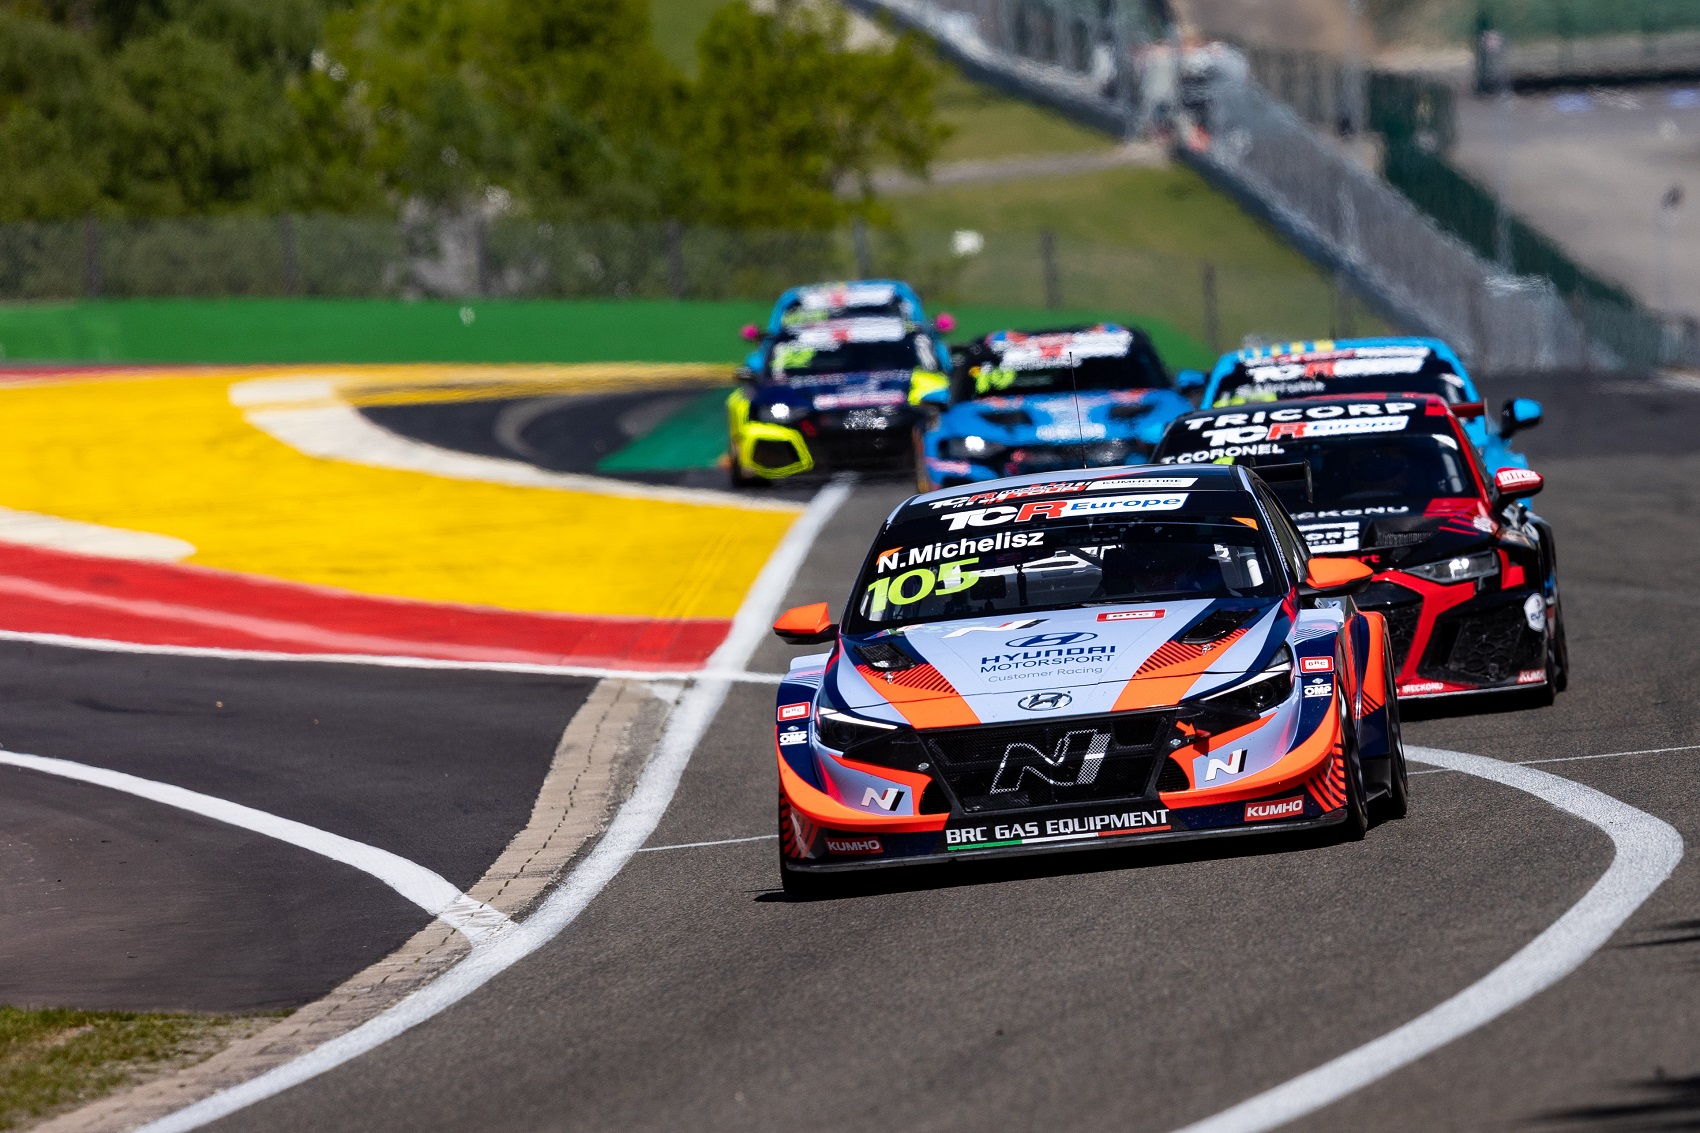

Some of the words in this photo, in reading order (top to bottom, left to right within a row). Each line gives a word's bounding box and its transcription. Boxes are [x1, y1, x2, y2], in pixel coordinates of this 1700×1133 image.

[1185, 402, 1416, 430] TRICORP
[1201, 421, 1307, 447] TCR
[940, 500, 1068, 531] TCR
[1070, 497, 1181, 511] Europe
[877, 532, 1044, 573] N.Michelisz
[867, 557, 980, 613] 105
[980, 655, 1116, 673] MOTORSPORT
[981, 646, 1116, 665] HYUNDAI
[988, 670, 1053, 683] Customer
[1057, 666, 1103, 676] Racing
[1304, 684, 1332, 697] OMP
[1247, 799, 1303, 817] KUMHO
[946, 826, 988, 844] BRC
[995, 821, 1039, 840] GAS
[1046, 809, 1170, 834] EQUIPMENT
[827, 840, 881, 852] KUMHO
